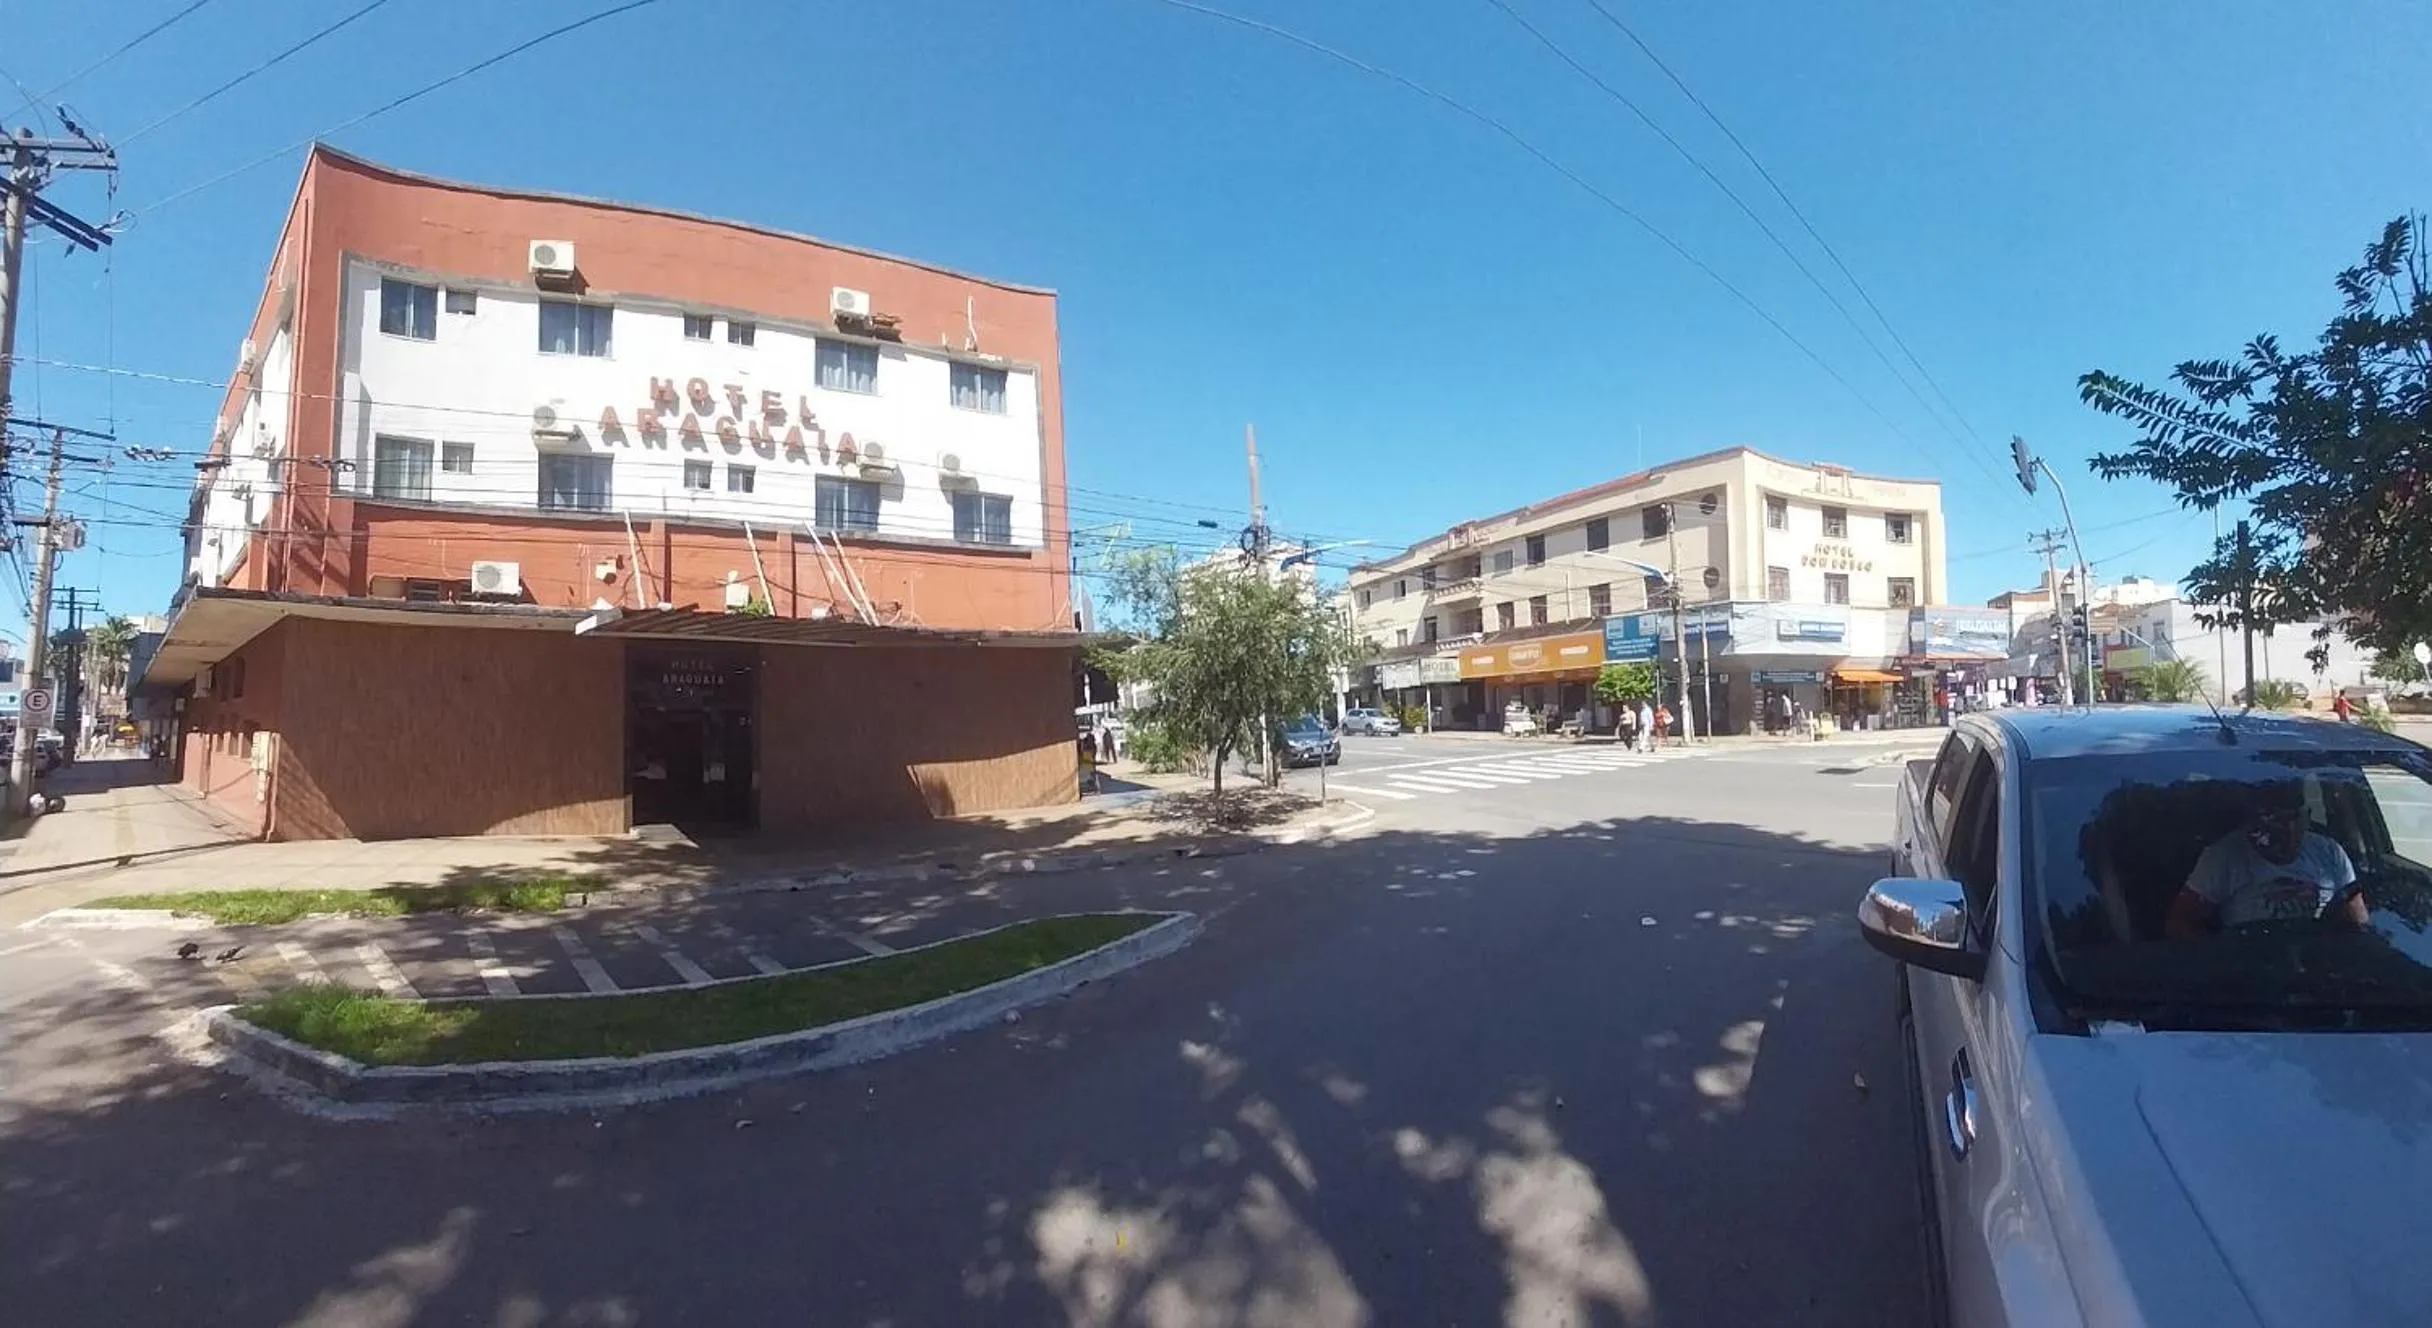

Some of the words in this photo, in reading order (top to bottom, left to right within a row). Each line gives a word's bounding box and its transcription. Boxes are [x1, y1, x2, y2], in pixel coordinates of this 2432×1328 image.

[650, 376, 818, 425] HOTEL
[599, 405, 857, 458] ARAGUAIA
[1814, 543, 1853, 557] HOTEL
[1424, 661, 1457, 672] HOTEL
[33, 695, 42, 706] E
